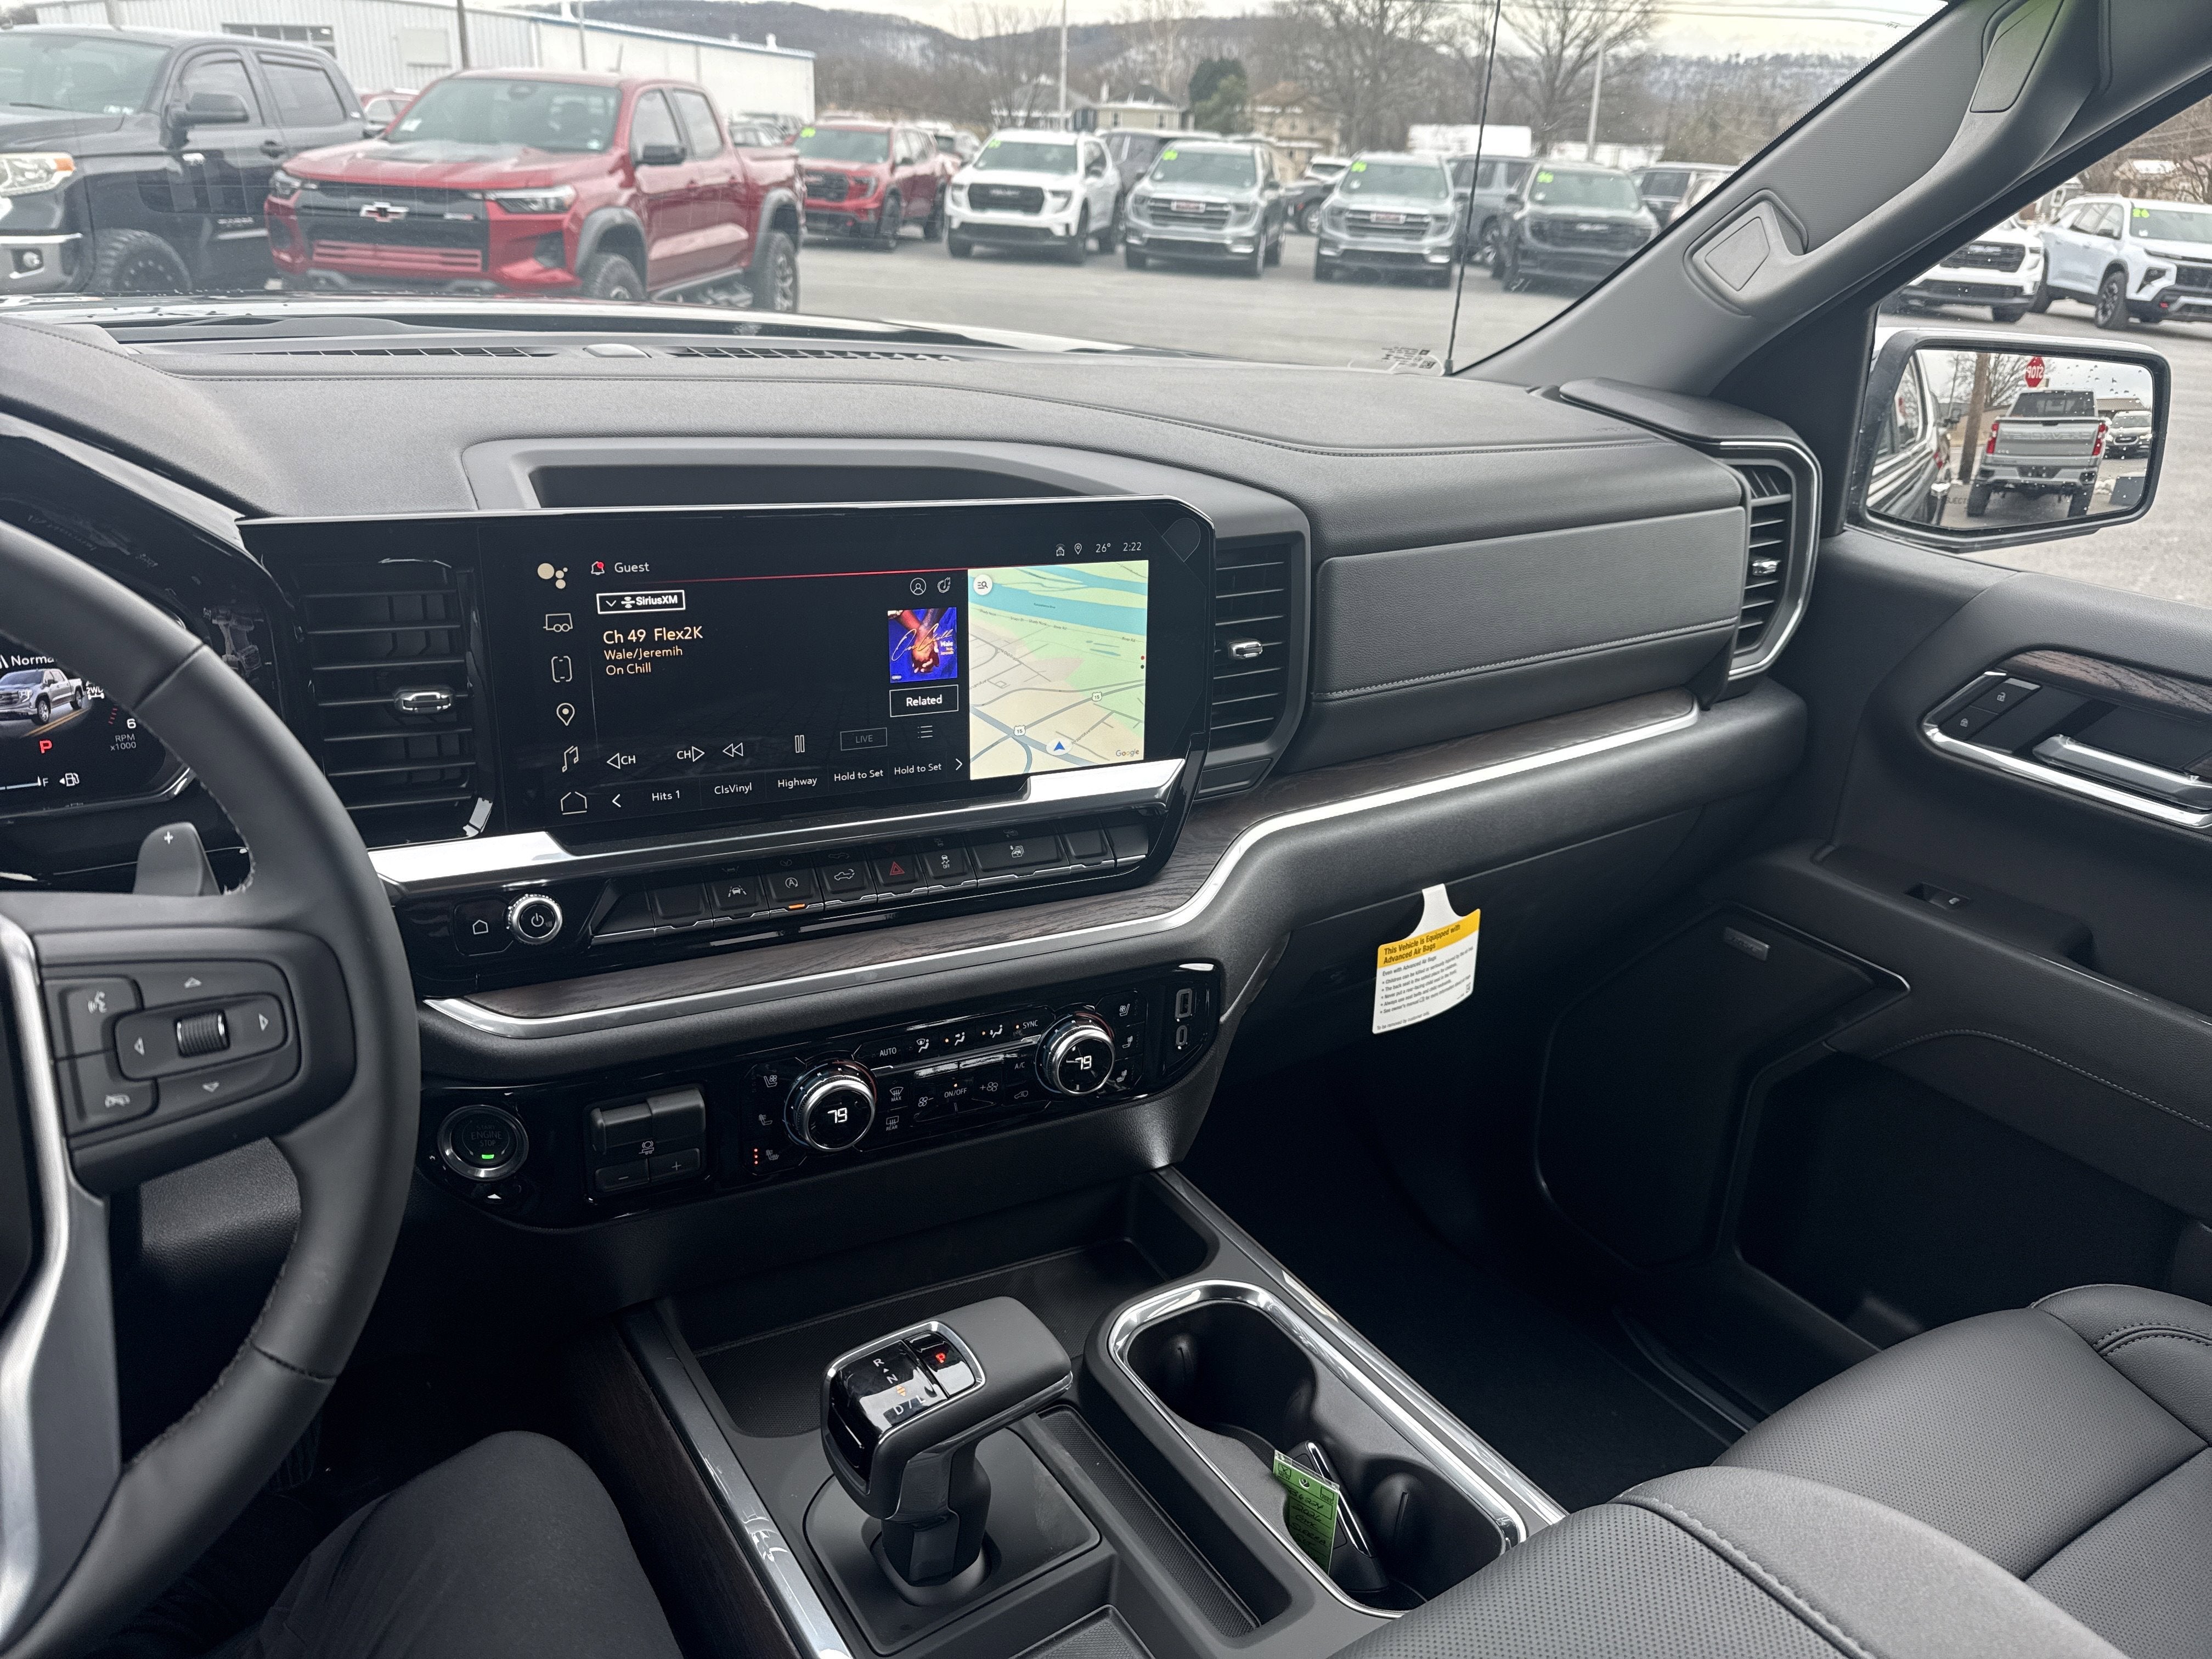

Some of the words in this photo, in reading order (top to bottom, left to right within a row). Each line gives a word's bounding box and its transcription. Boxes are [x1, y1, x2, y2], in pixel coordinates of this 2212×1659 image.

[1096, 543, 1111, 553] 26°
[1123, 542, 1142, 552] 2:22
[614, 562, 650, 574] Guest
[635, 594, 678, 606] SiriusXM
[603, 630, 624, 644] Ch
[628, 629, 646, 642] 49
[654, 626, 704, 641] Flex2K
[604, 646, 684, 661] Wale/Jeremih
[11, 655, 57, 667] Norma
[606, 664, 624, 676] On
[627, 663, 652, 674] Chill
[906, 695, 943, 707] Related
[127, 719, 137, 729] 6
[115, 734, 136, 742] RPM
[855, 733, 873, 743] LIVE
[40, 740, 53, 753] P
[110, 742, 137, 752] x1000
[676, 749, 691, 760] CH
[1116, 749, 1139, 757] Google
[621, 754, 636, 765] CH
[833, 771, 856, 782] Hold
[859, 770, 867, 780] to
[869, 769, 884, 779] Set
[894, 765, 914, 776] Hold
[916, 765, 924, 774] to
[927, 763, 942, 772] Set
[42, 778, 49, 787] F
[778, 777, 817, 789] Highway
[714, 783, 753, 795] ClsVinyl
[652, 791, 673, 802] Hits
[675, 790, 680, 799] 1
[1384, 946, 1397, 955] This
[1398, 940, 1419, 951] Vehicle
[1426, 928, 1449, 943] Equipped
[1451, 924, 1460, 933] with
[1384, 950, 1412, 964] Advanced
[1413, 947, 1422, 956] Air
[1423, 943, 1436, 952] Bags
[1023, 1020, 1039, 1029] SYNC
[879, 1047, 897, 1057] AUTO
[1075, 1055, 1092, 1070] 79
[944, 1088, 967, 1098] ON/OFF
[827, 1107, 848, 1124] 79
[471, 1131, 503, 1140] ENGINE
[873, 1358, 885, 1367] R
[935, 1352, 946, 1363] P
[886, 1374, 899, 1384] N
